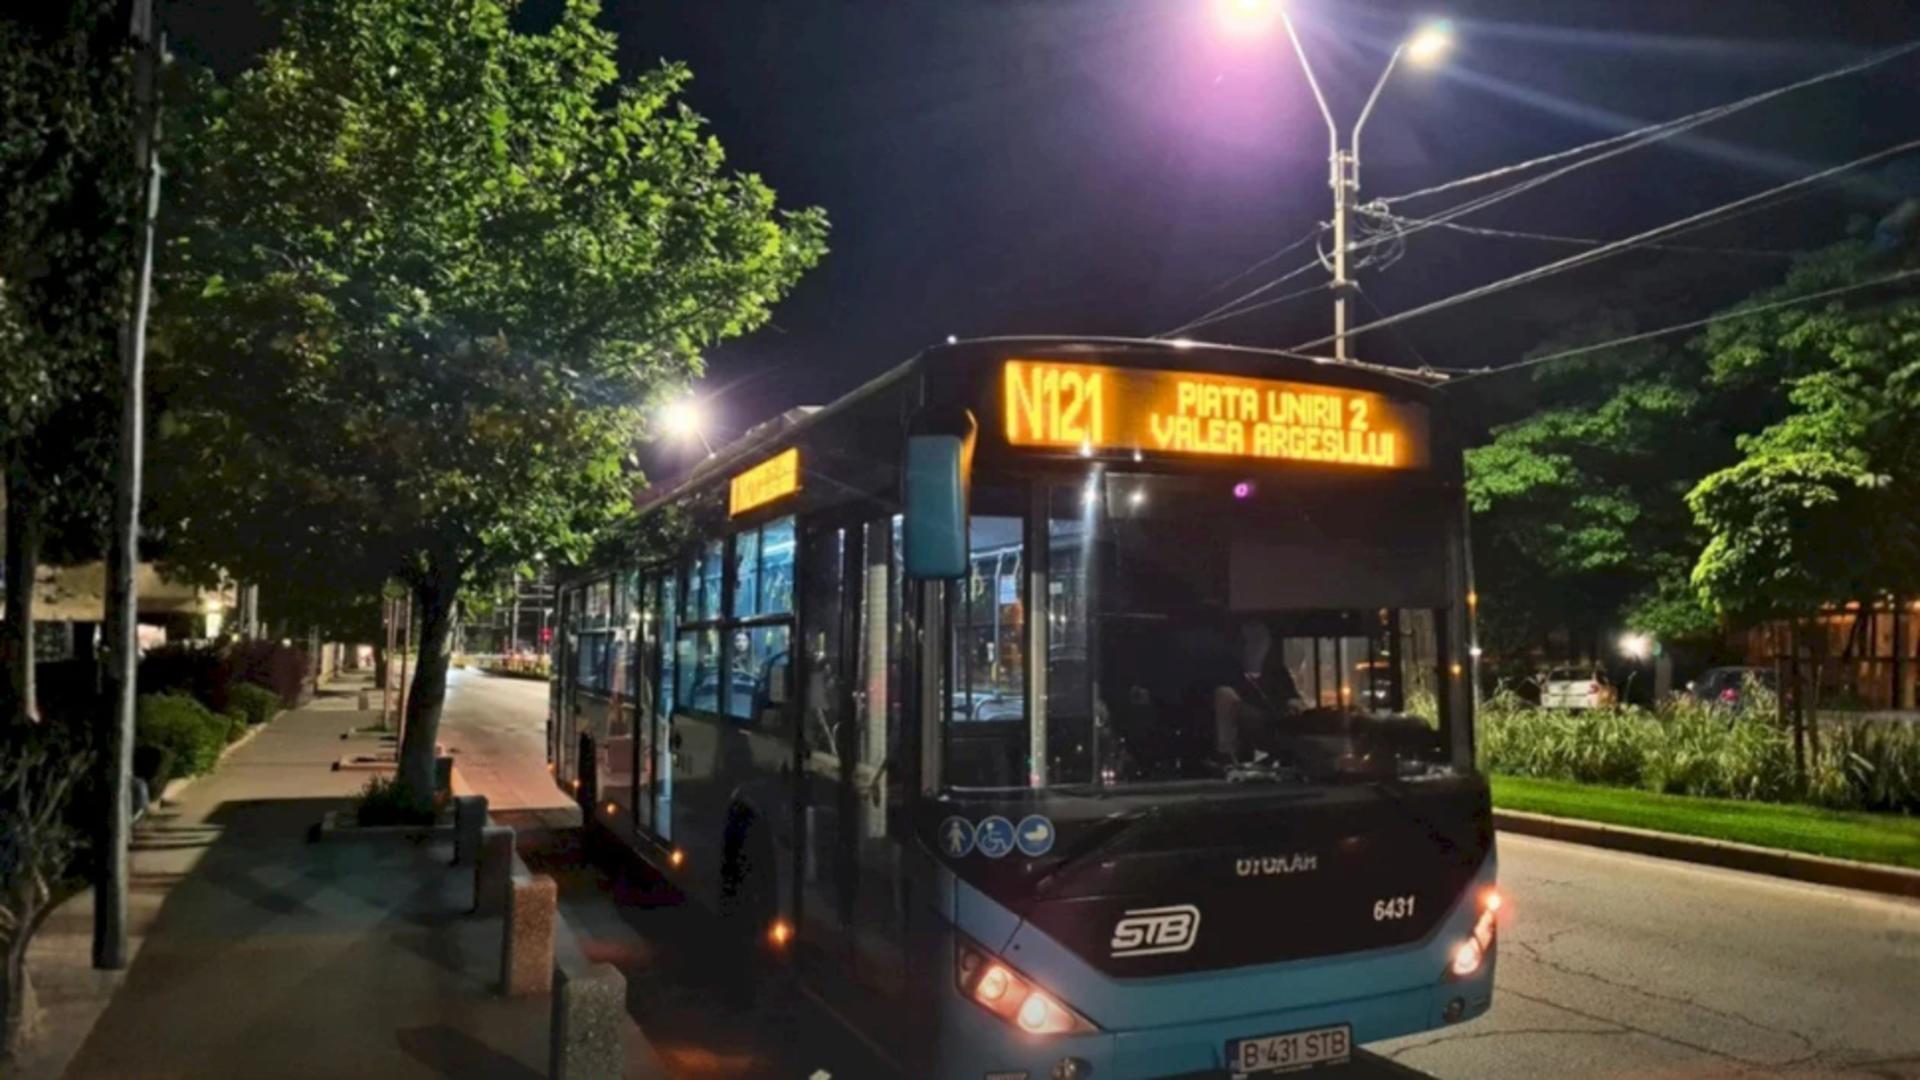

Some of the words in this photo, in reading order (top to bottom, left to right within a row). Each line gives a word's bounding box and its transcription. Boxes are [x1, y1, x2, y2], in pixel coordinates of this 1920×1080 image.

[1006, 361, 1102, 443] N121
[1178, 381, 1258, 420] PIATA
[1268, 391, 1342, 427] UNIRII
[1348, 399, 1370, 430] 2
[1151, 413, 1244, 452] VALEA
[1253, 427, 1395, 466] ARGESULUI
[1373, 894, 1416, 921] 6431
[1111, 914, 1192, 950] STB
[1243, 1042, 1259, 1068] B
[1267, 1037, 1299, 1064] 431
[1305, 1030, 1346, 1059] STB
